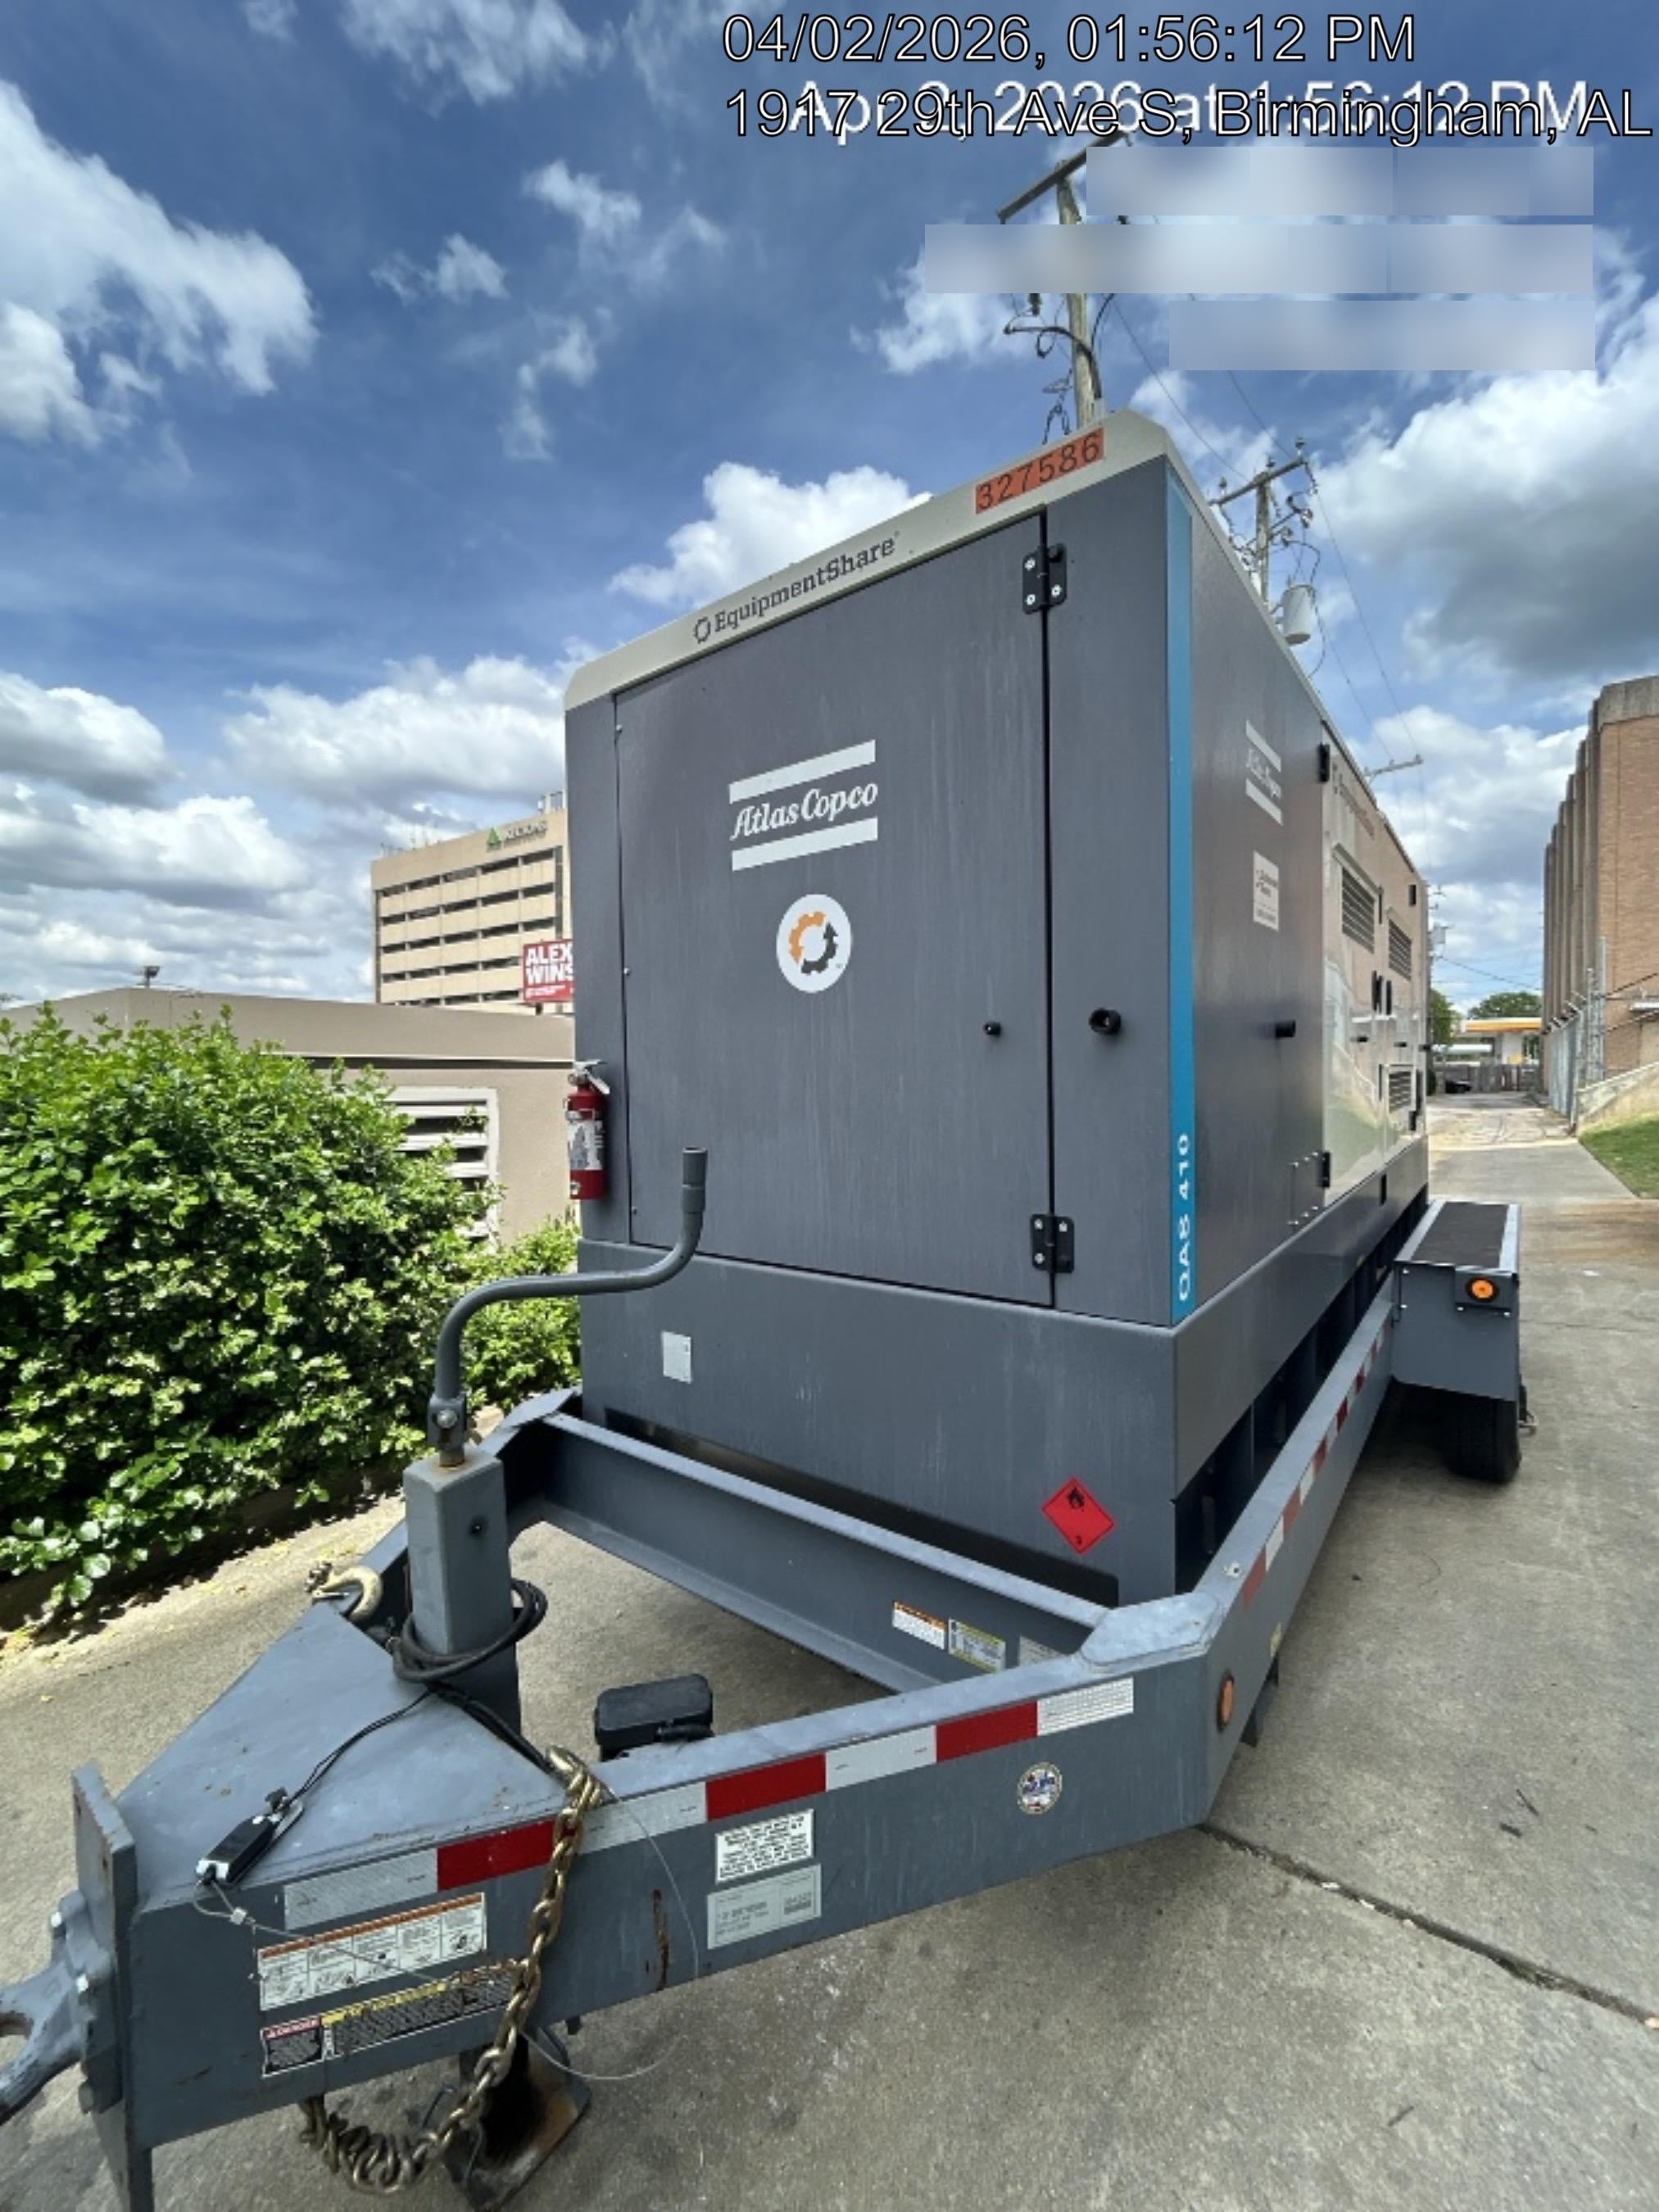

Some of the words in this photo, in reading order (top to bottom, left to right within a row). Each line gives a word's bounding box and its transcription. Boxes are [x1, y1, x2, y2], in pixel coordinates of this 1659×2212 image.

[977, 435, 1101, 512] 327586
[714, 536, 896, 631] EquipmentShare
[525, 943, 573, 967] ALEX
[1177, 1133, 1190, 1200] 410
